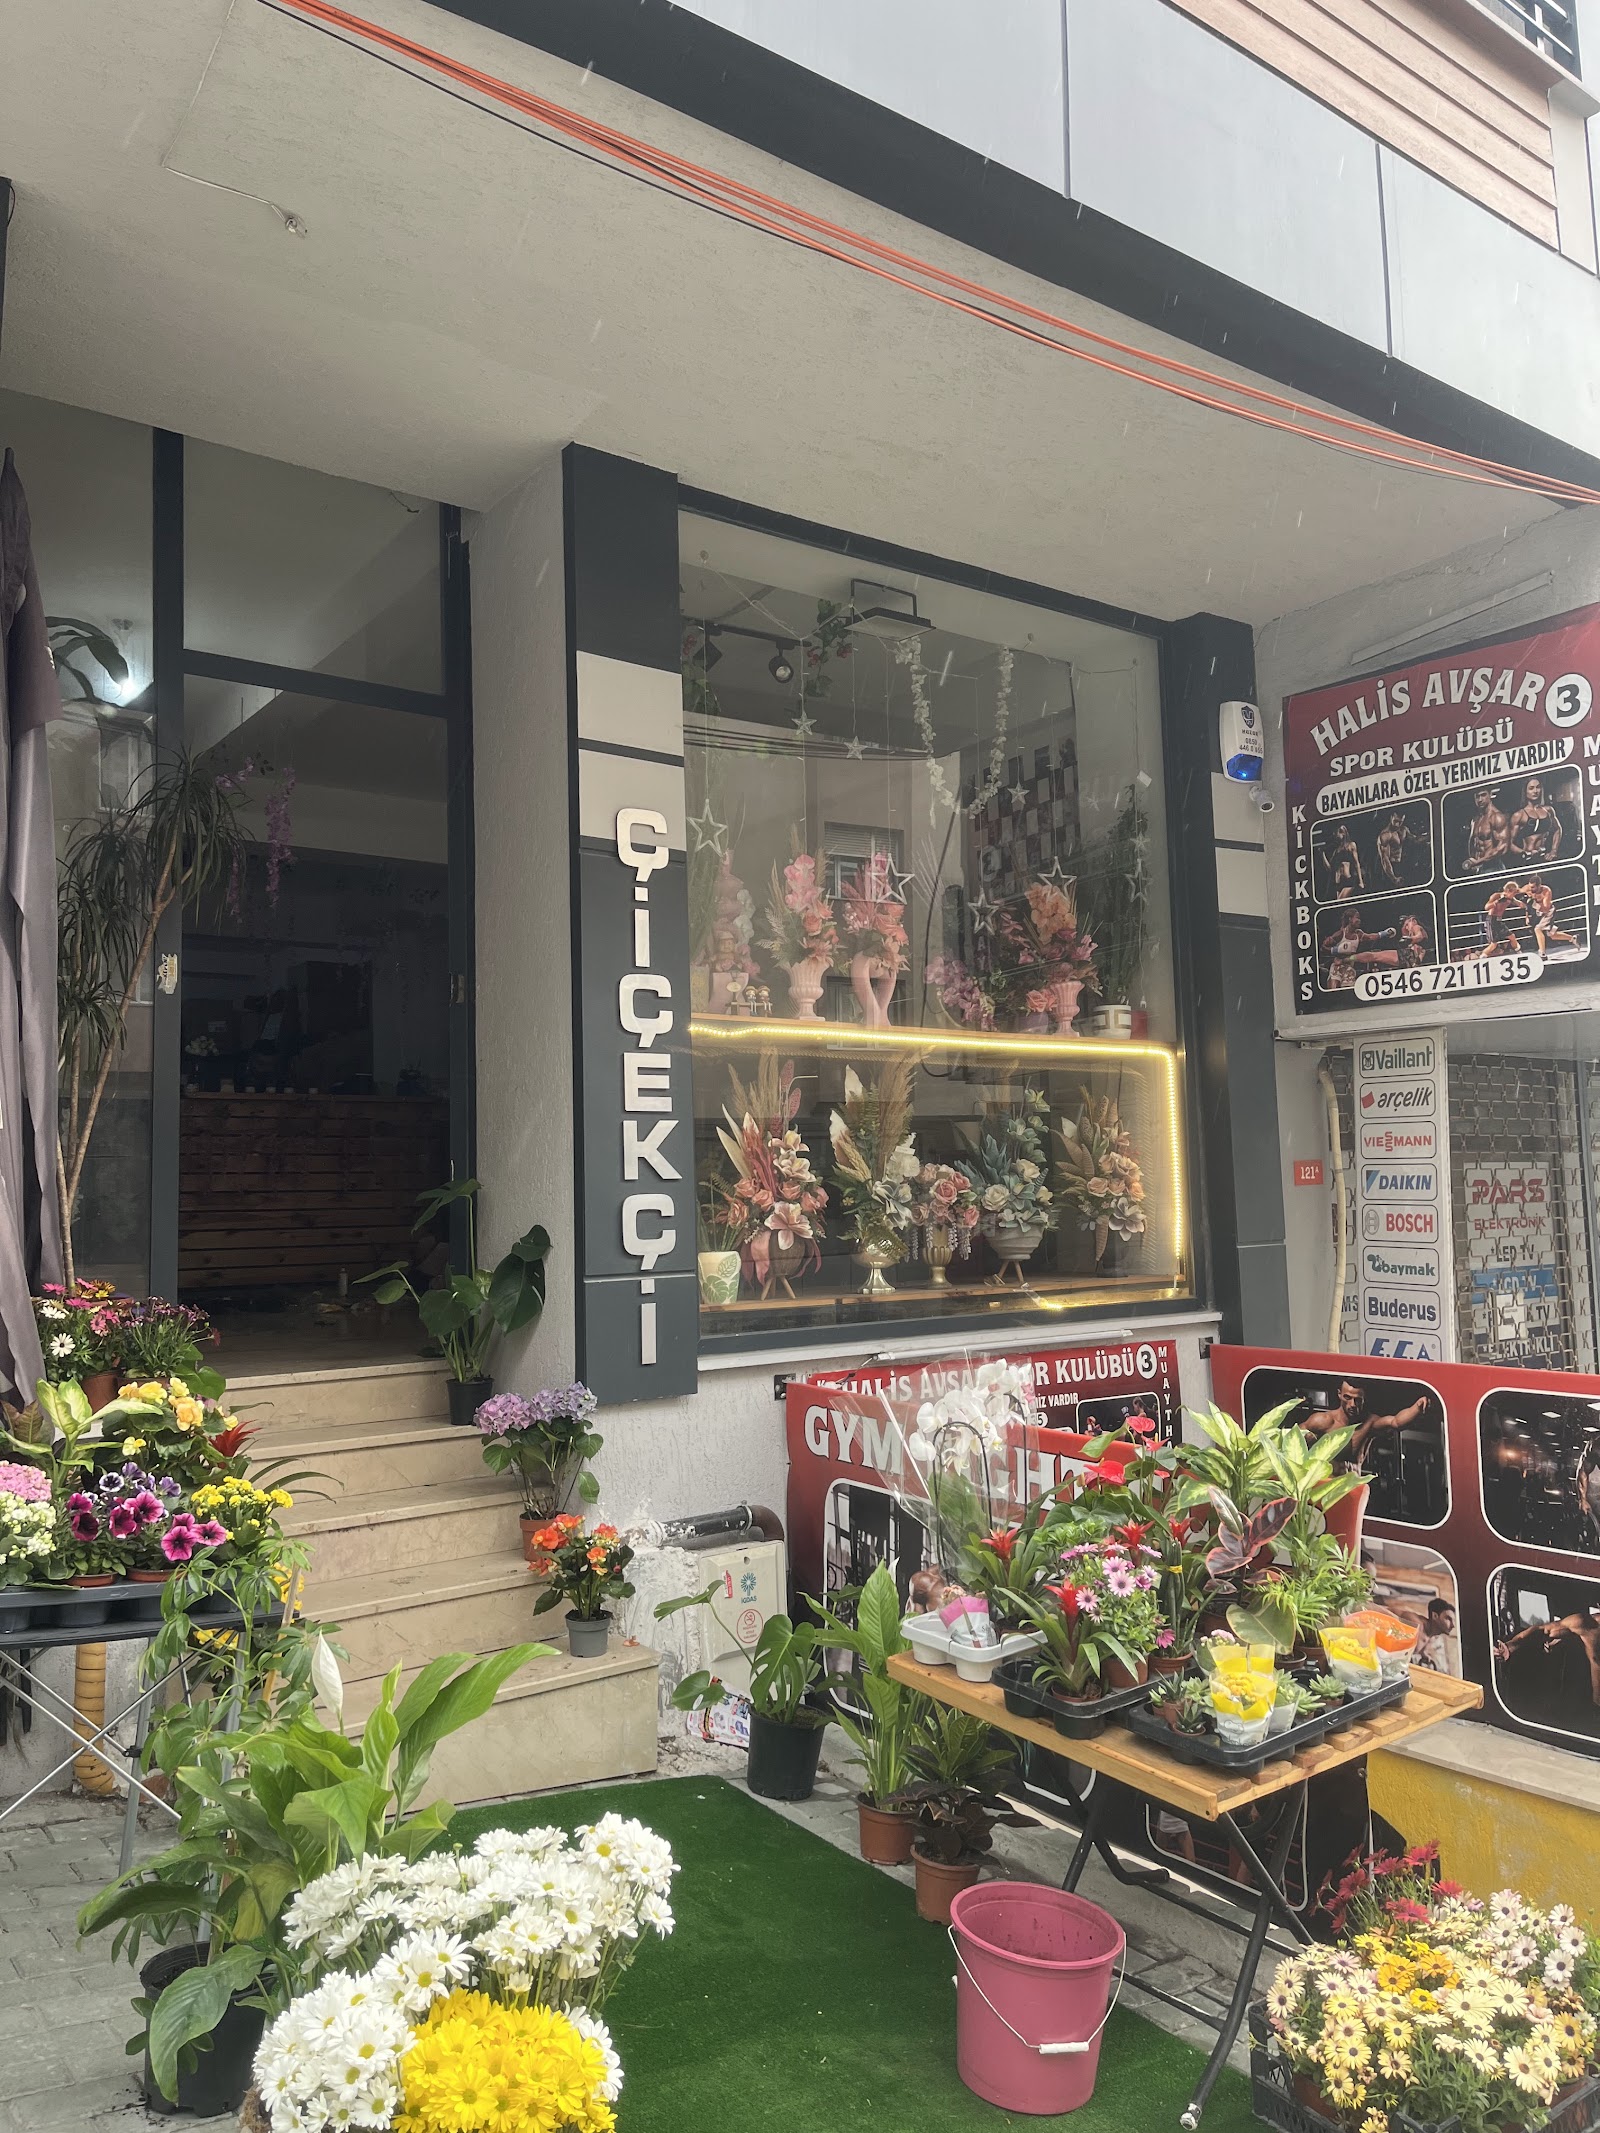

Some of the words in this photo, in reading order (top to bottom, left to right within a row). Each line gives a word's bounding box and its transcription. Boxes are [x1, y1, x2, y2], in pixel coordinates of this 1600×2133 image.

[1310, 680, 1411, 756] HALİS
[1422, 667, 1547, 714] AVŞAR
[1330, 746, 1394, 777] SPOR
[1402, 716, 1514, 763] KULÜBÜ
[1320, 780, 1399, 813] BAYANLARA
[1403, 769, 1440, 794] ÖZEL
[1505, 740, 1567, 771] VARDIR
[1364, 971, 1423, 998] 0546
[1430, 964, 1467, 990] 721
[1474, 960, 1492, 985] 11
[1499, 956, 1532, 982] 35
[1375, 1045, 1432, 1070] Vaillant
[615, 807, 682, 1366] ÇİÇEKÇİ
[1377, 1086, 1433, 1112] arçelik
[1379, 1173, 1433, 1191] DAIKIN
[1472, 1178, 1546, 1204] PARS
[1386, 1213, 1434, 1234] BOSCH
[1520, 1243, 1535, 1261] TV
[1381, 1260, 1436, 1277] baymak
[1368, 1296, 1437, 1322] Buderus
[1536, 1304, 1550, 1320] TV
[1055, 1347, 1135, 1384] KULÜBÜ
[805, 1404, 904, 1476] GYM
